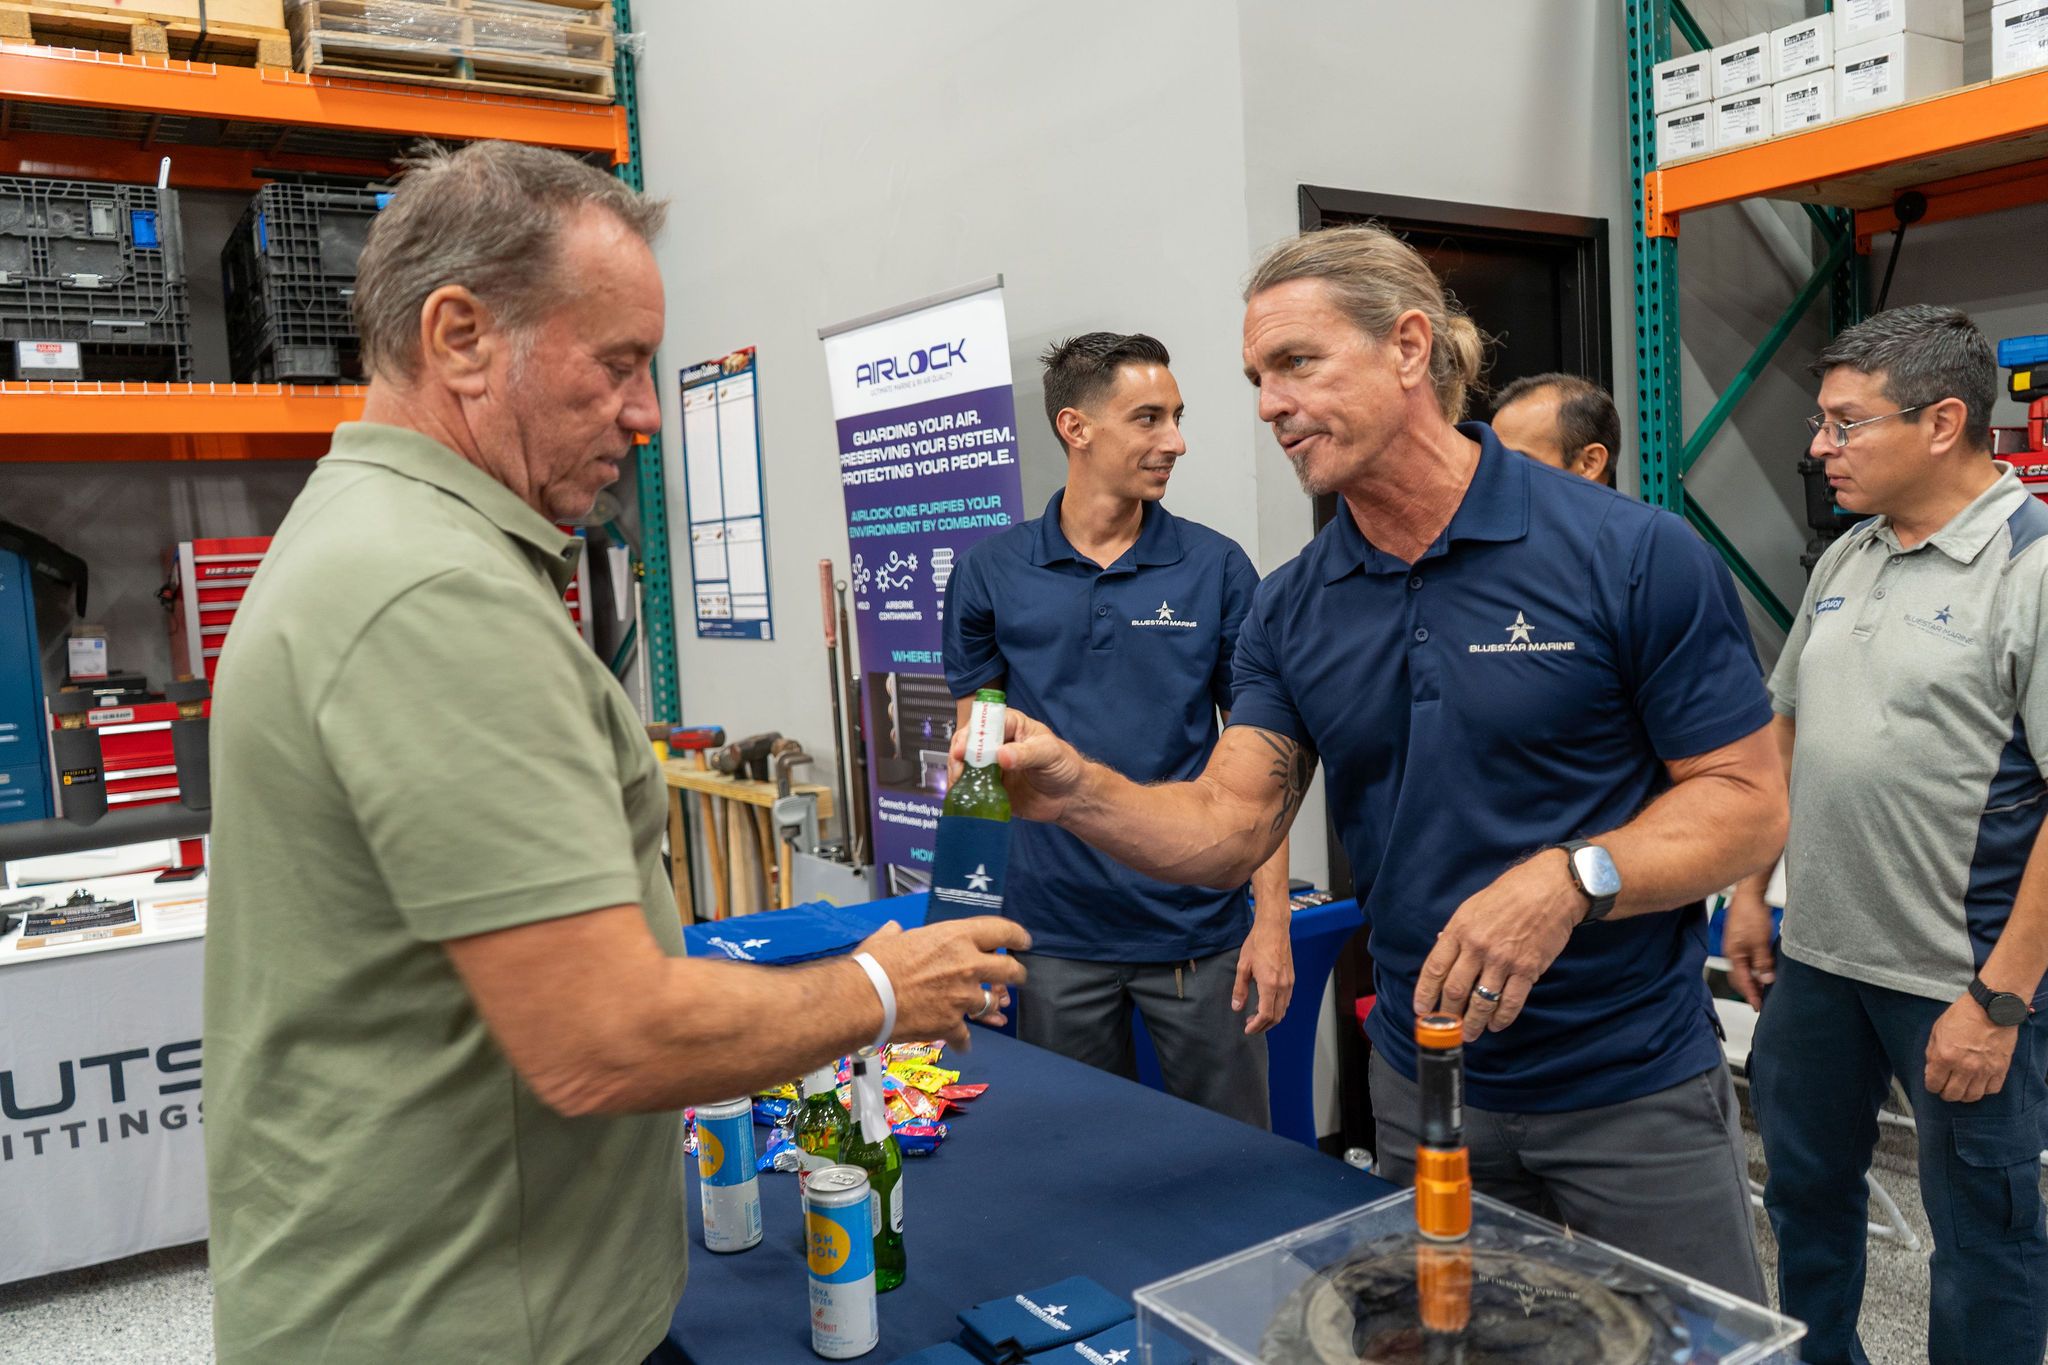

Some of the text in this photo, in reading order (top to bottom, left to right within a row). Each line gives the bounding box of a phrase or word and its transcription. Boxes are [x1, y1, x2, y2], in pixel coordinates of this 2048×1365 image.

[856, 338, 967, 388] AIRLOCK
[852, 410, 982, 446] GUARDING YOUR AIR.
[840, 426, 1016, 467] PRESERVING YOUR SYSTEM.
[842, 448, 1015, 486] PROTECTING YOUR PEOPLE.
[851, 495, 1002, 522] AIRLOCK ONE PURIFIES YOUR
[849, 513, 1012, 539] ENVIRONMENT BY COMBATING:
[1131, 619, 1197, 628] BLUESTAR MARINE
[1903, 614, 1943, 633] BLUESTAR
[1943, 628, 1976, 645] MARINE
[891, 650, 943, 664] WHERE IT
[1469, 641, 1576, 653] BLUESTAR MARINE
[878, 797, 906, 811] Connects
[907, 801, 931, 816] directly
[888, 813, 923, 827] continuous
